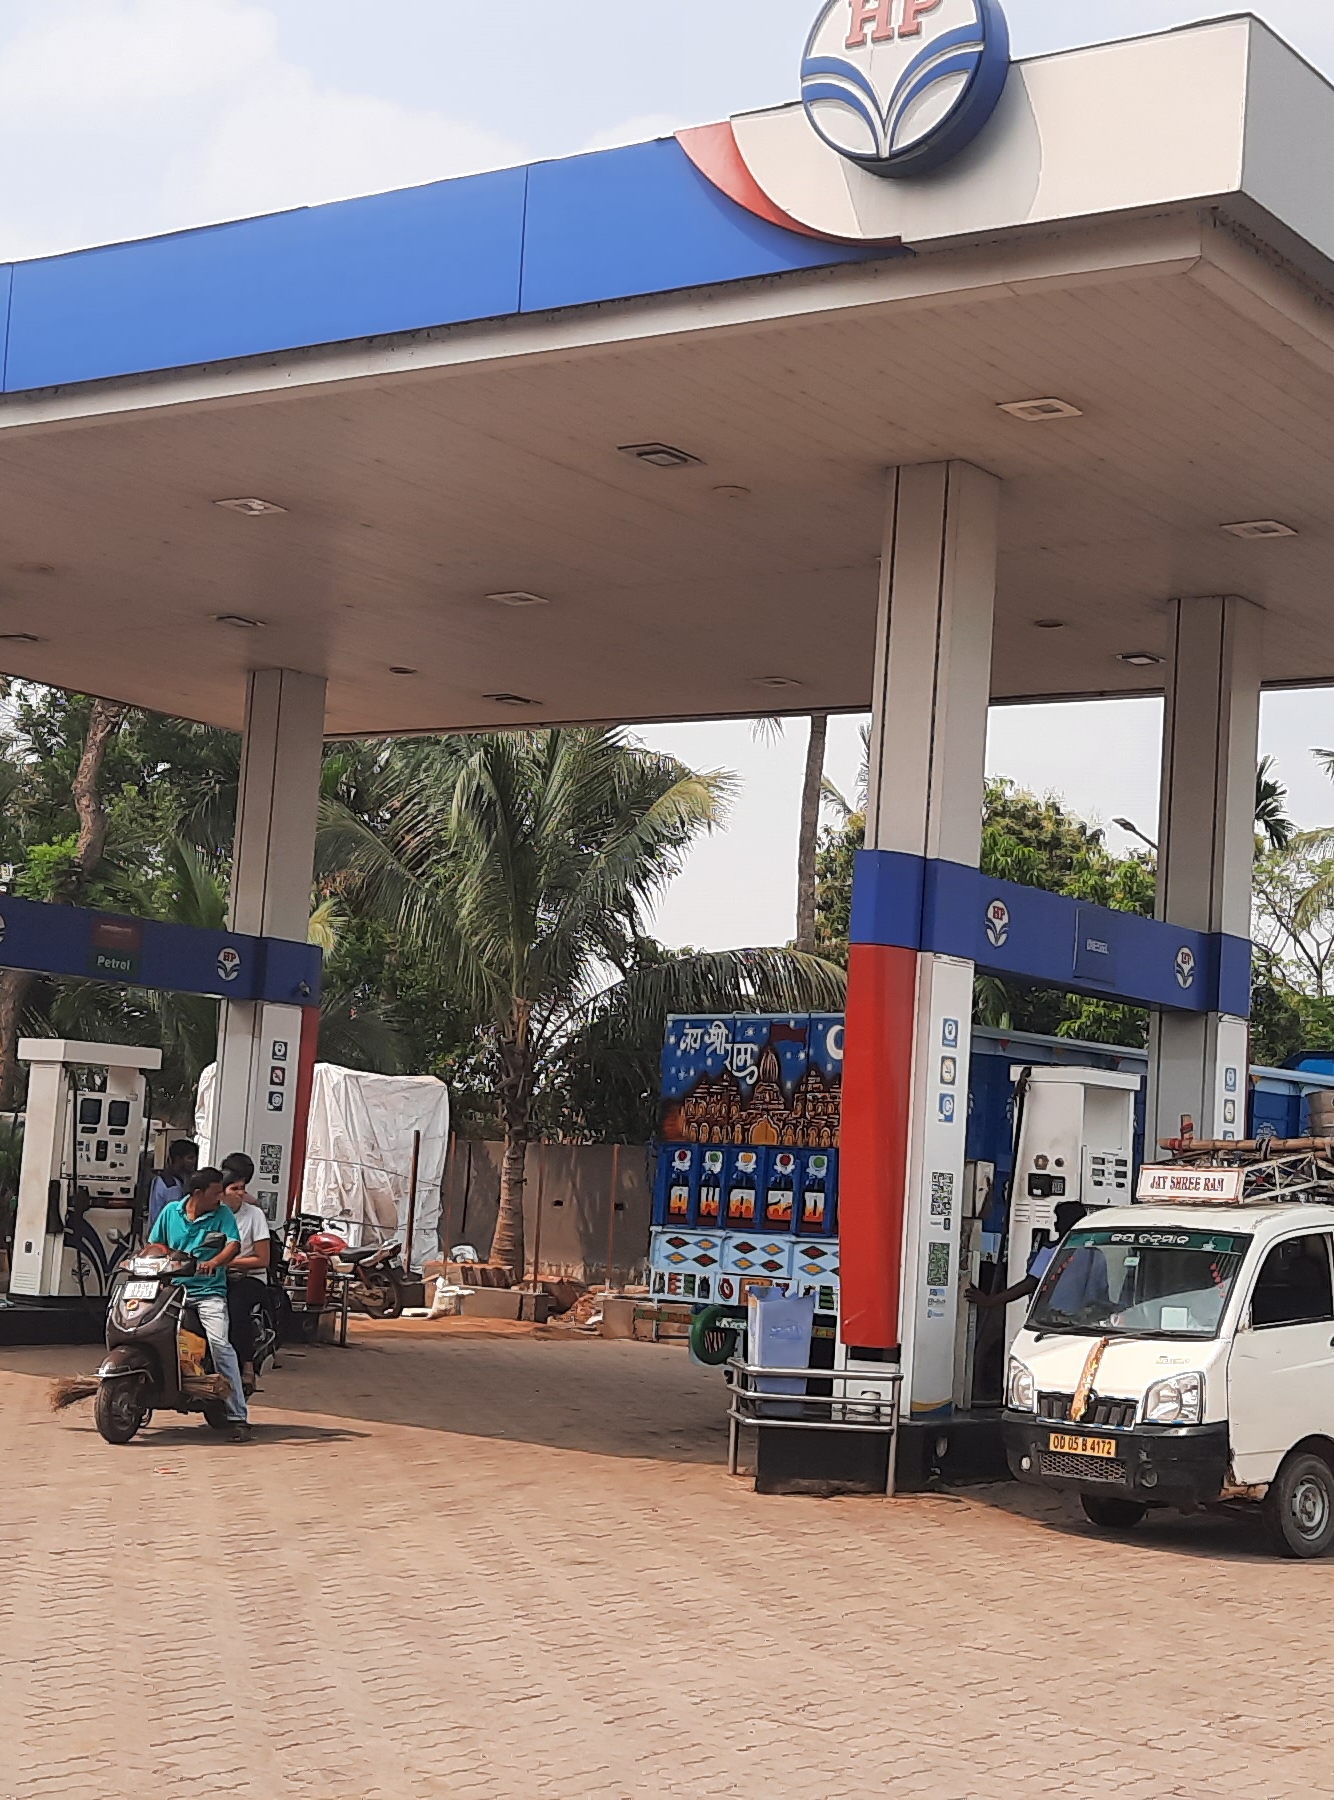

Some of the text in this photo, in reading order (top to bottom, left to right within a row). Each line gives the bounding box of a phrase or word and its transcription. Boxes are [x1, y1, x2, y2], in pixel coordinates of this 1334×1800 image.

[845, 0, 942, 48] HP
[992, 905, 1005, 921] HP
[97, 955, 131, 971] Petrol
[223, 951, 236, 963] HP
[680, 1021, 728, 1056] जय श्री
[724, 1043, 759, 1084] राम
[1150, 1175, 1224, 1192] JAY SHREE RAM
[1053, 1434, 1065, 1450] OD
[1068, 1435, 1079, 1451] 05
[1090, 1438, 1112, 1455] 4172
